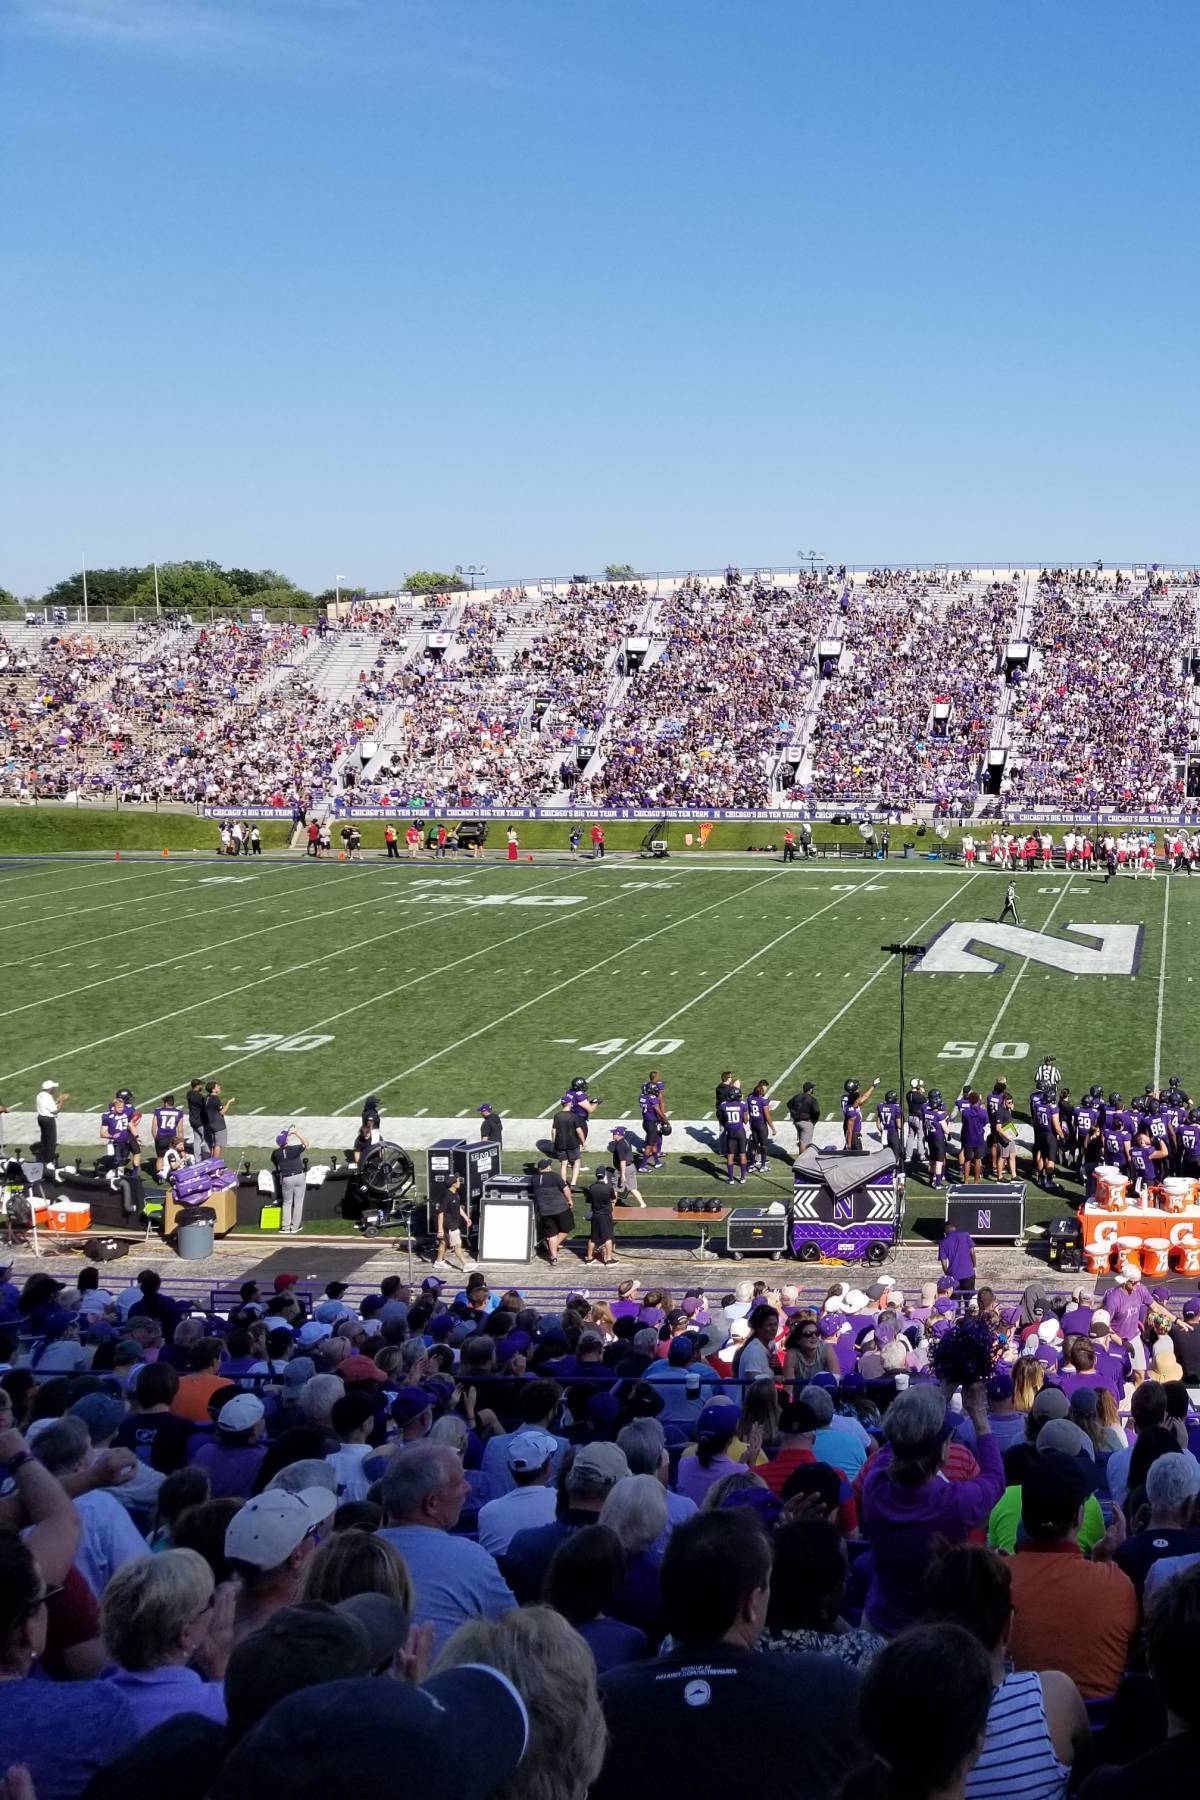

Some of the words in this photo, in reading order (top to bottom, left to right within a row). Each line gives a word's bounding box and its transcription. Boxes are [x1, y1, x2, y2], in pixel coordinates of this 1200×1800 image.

[634, 810, 666, 818] CHICAGO'S
[666, 810, 678, 818] BIG
[678, 810, 692, 818] TEN
[693, 810, 708, 818] TEAM
[1020, 814, 1050, 822] CHICAGO'S
[1051, 814, 1061, 822] BIG
[1062, 814, 1074, 822] TEN
[1074, 814, 1092, 822] TEAM
[905, 920, 1145, 976] N
[222, 1034, 336, 1051] 30
[577, 1038, 686, 1056] 40
[936, 1041, 1030, 1059] 50
[116, 1117, 129, 1131] 43
[160, 1115, 176, 1129] 14
[726, 1111, 740, 1123] 10
[881, 1112, 892, 1125] 17
[1078, 1117, 1091, 1129] 29
[1150, 1123, 1166, 1136] 89
[1182, 1136, 1196, 1149] 87
[834, 1193, 854, 1219] N
[58, 1212, 67, 1223] G
[977, 1209, 991, 1229] N
[1094, 1221, 1118, 1247] G
[1170, 1222, 1194, 1246] G
